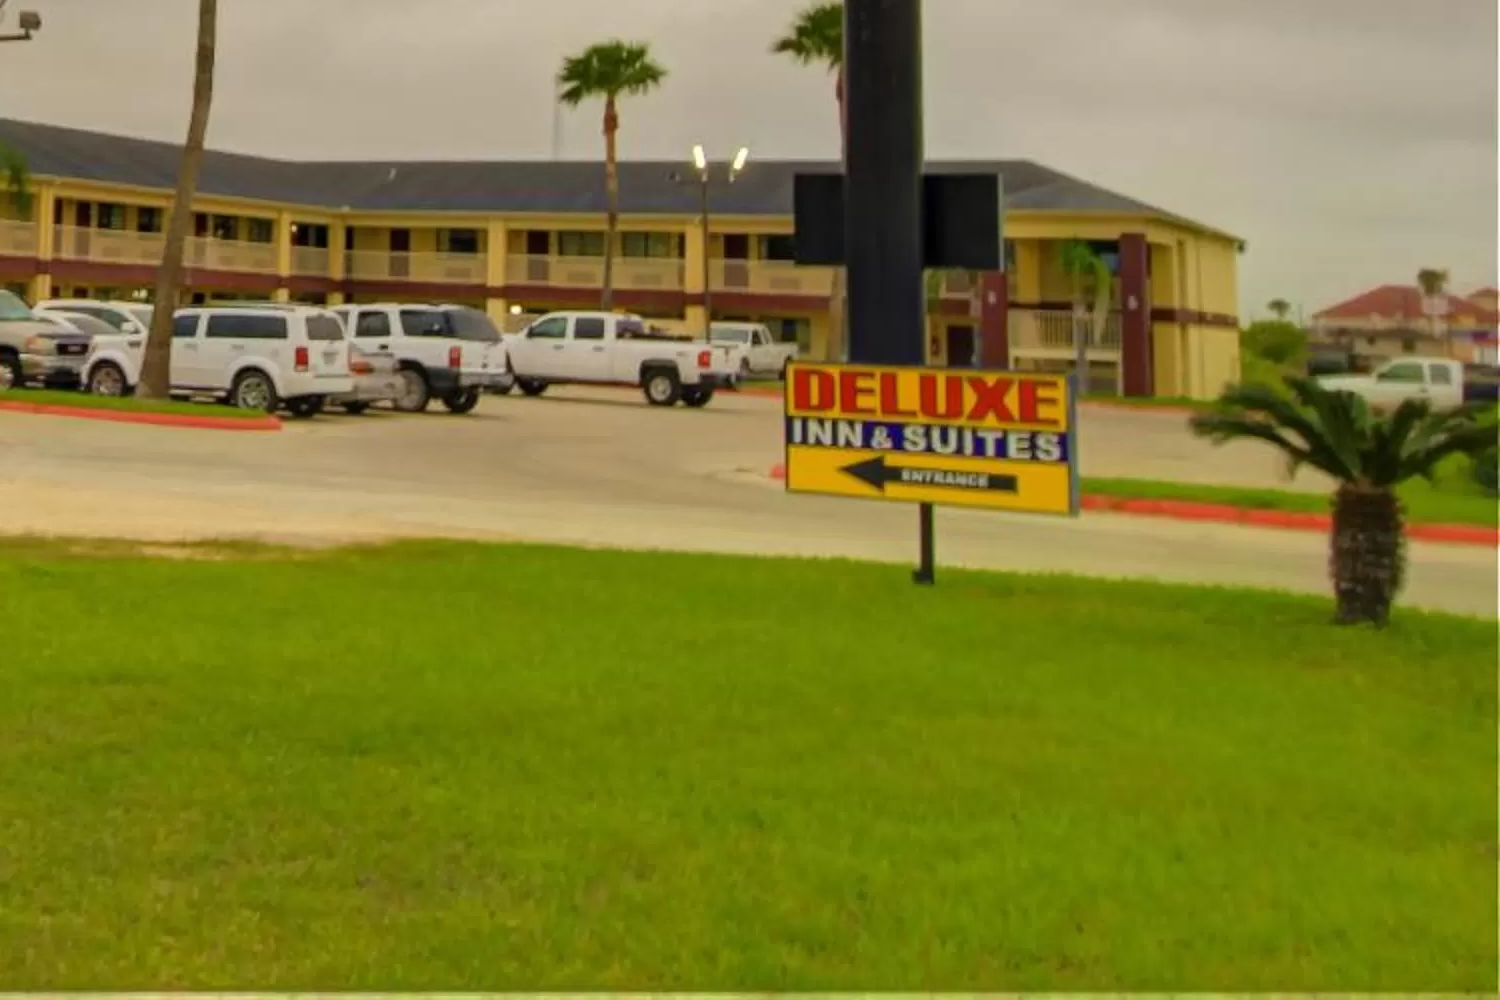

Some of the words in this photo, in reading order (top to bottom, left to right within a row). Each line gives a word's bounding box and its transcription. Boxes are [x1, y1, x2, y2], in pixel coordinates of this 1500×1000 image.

[793, 368, 1060, 426] DELUXE
[791, 417, 864, 447] INN
[869, 425, 893, 450] &
[902, 423, 1062, 462] SUITES
[901, 468, 990, 489] ENTRANCE
